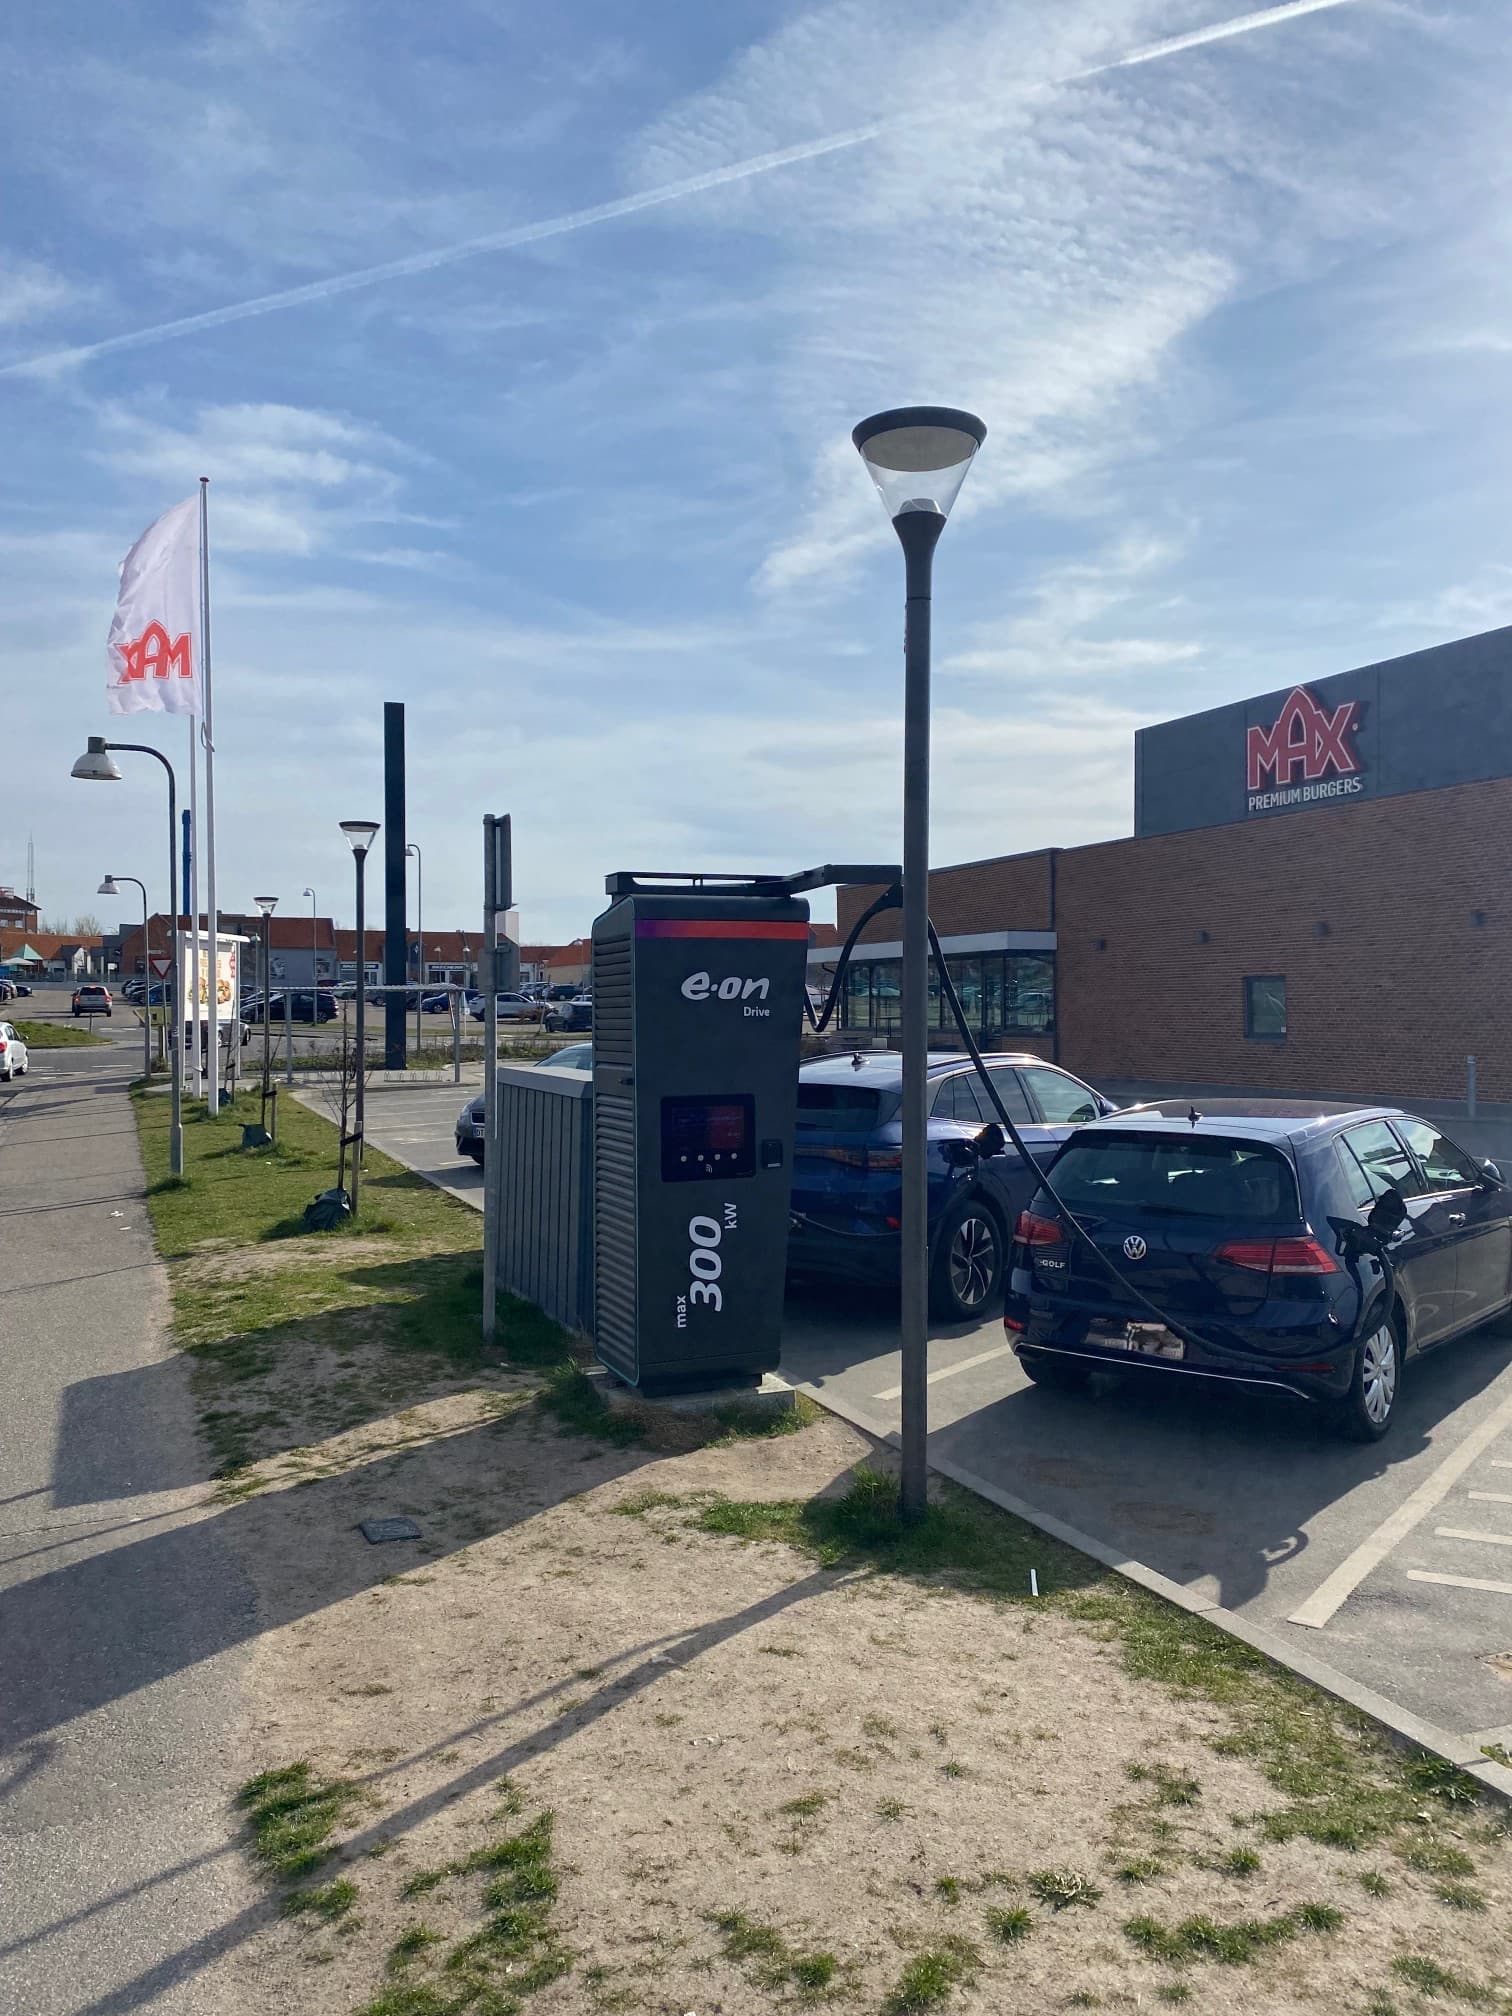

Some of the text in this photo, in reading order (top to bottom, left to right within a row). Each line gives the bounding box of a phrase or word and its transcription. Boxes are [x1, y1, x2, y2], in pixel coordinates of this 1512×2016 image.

[1247, 685, 1360, 791] MAX
[1248, 777, 1361, 811] PREMIUM BURGERS
[743, 1006, 770, 1017] Drive
[676, 1202, 737, 1329] max 300 kW
